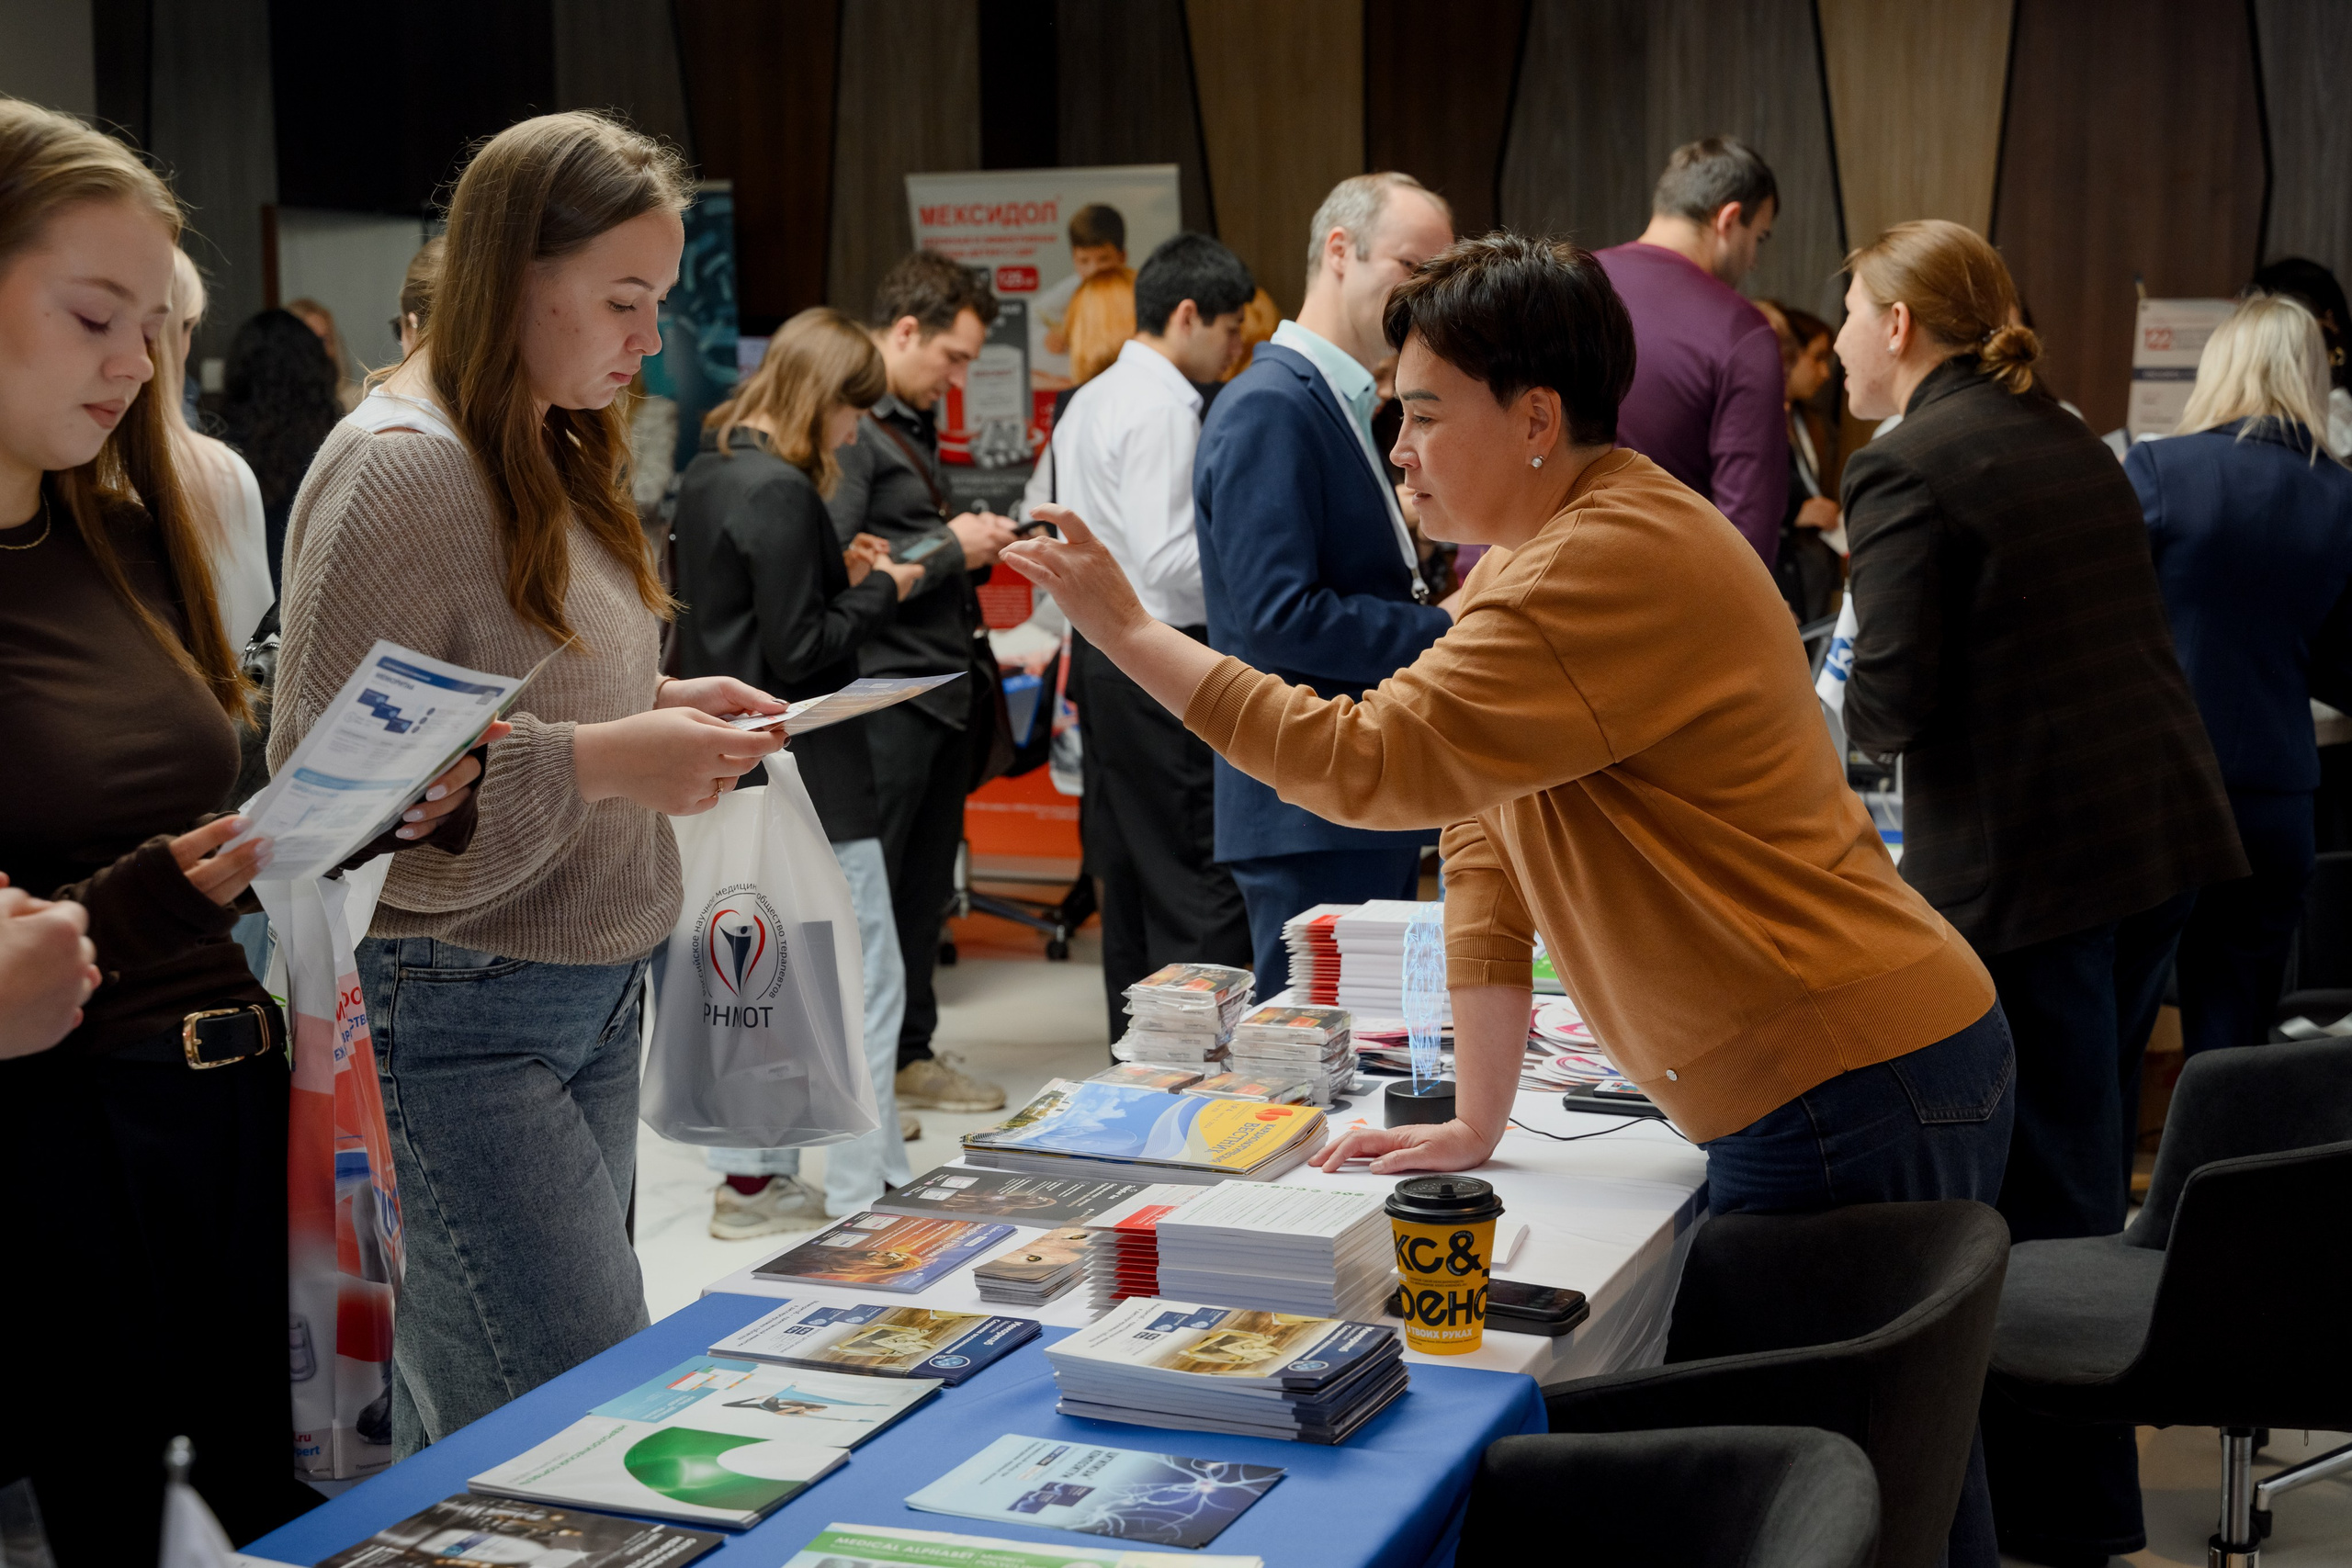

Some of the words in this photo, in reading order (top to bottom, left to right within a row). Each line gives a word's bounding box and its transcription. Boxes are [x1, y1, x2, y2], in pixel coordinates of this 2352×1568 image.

[920, 200, 1057, 227] МЕКСИДОЛ
[756, 892, 786, 938] общество
[768, 939, 788, 999] терапевтов
[1204, 1122, 1261, 1154] ВЕСТНИК
[980, 1320, 1024, 1346] Меморитаб
[1411, 1325, 1441, 1339] ТВОИХ
[1442, 1327, 1473, 1339] РУКАХ
[833, 1536, 899, 1552] MEDICAL
[901, 1544, 975, 1560] ALPHABET
